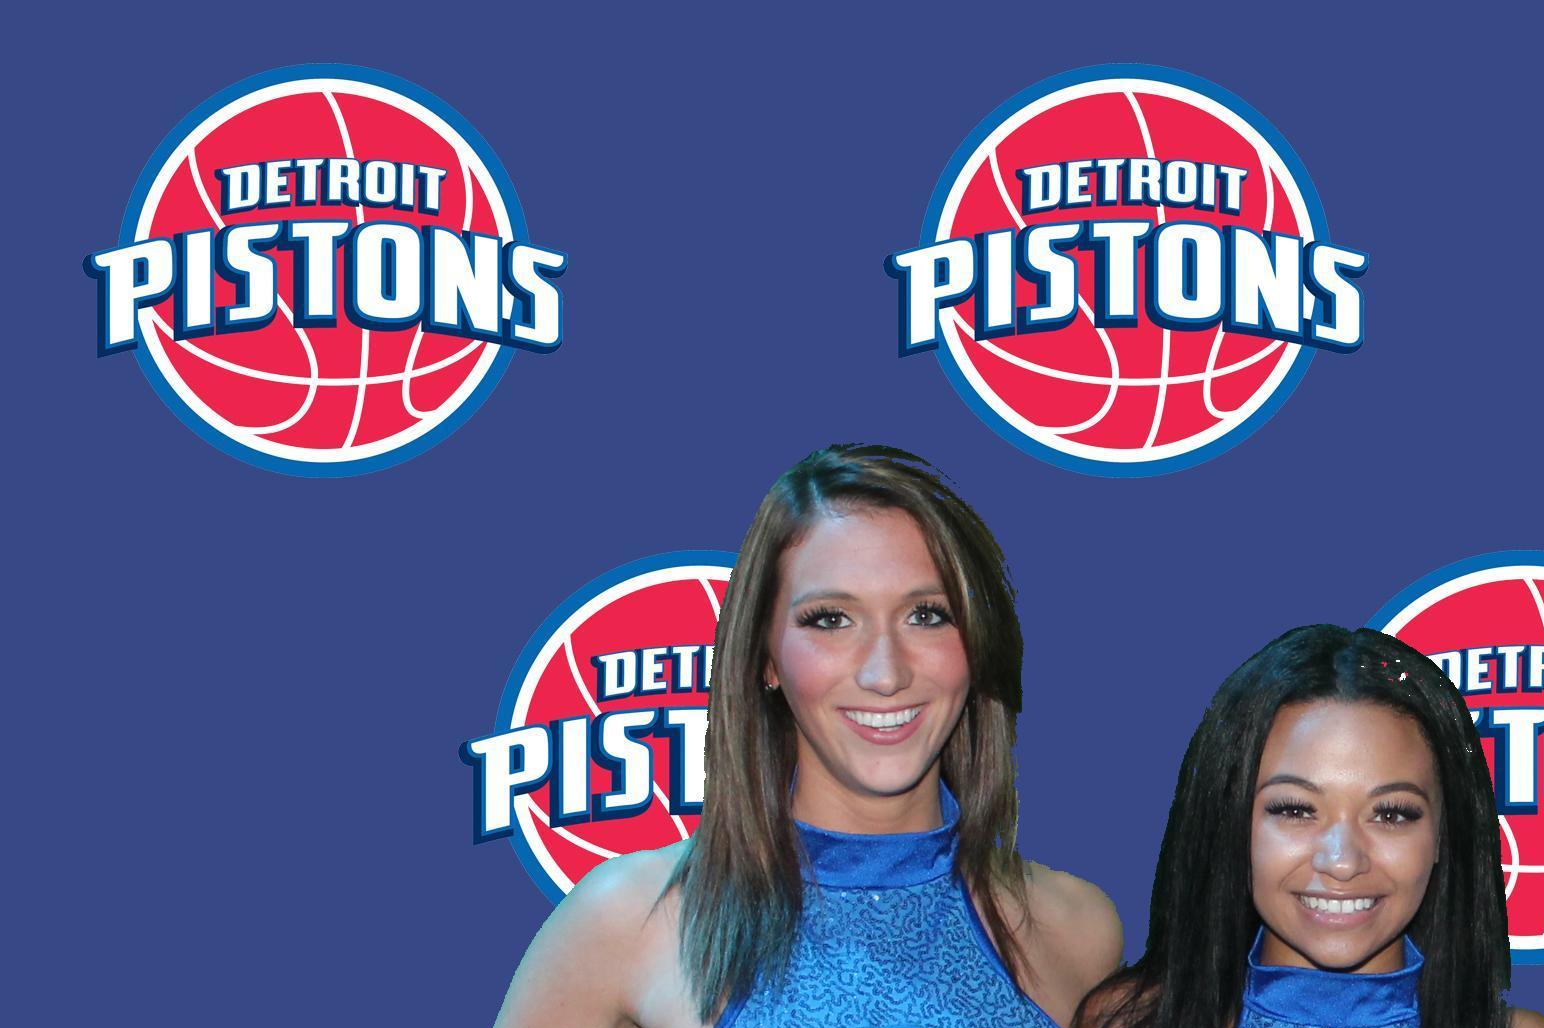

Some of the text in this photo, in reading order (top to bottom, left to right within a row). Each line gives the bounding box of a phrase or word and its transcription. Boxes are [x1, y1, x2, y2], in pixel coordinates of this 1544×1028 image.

[217, 158, 447, 213] DETROIT
[1018, 158, 1248, 213] DETROIT
[84, 219, 567, 355] PISTONS
[885, 219, 1368, 355] PISTONS
[460, 707, 710, 843] PIST
